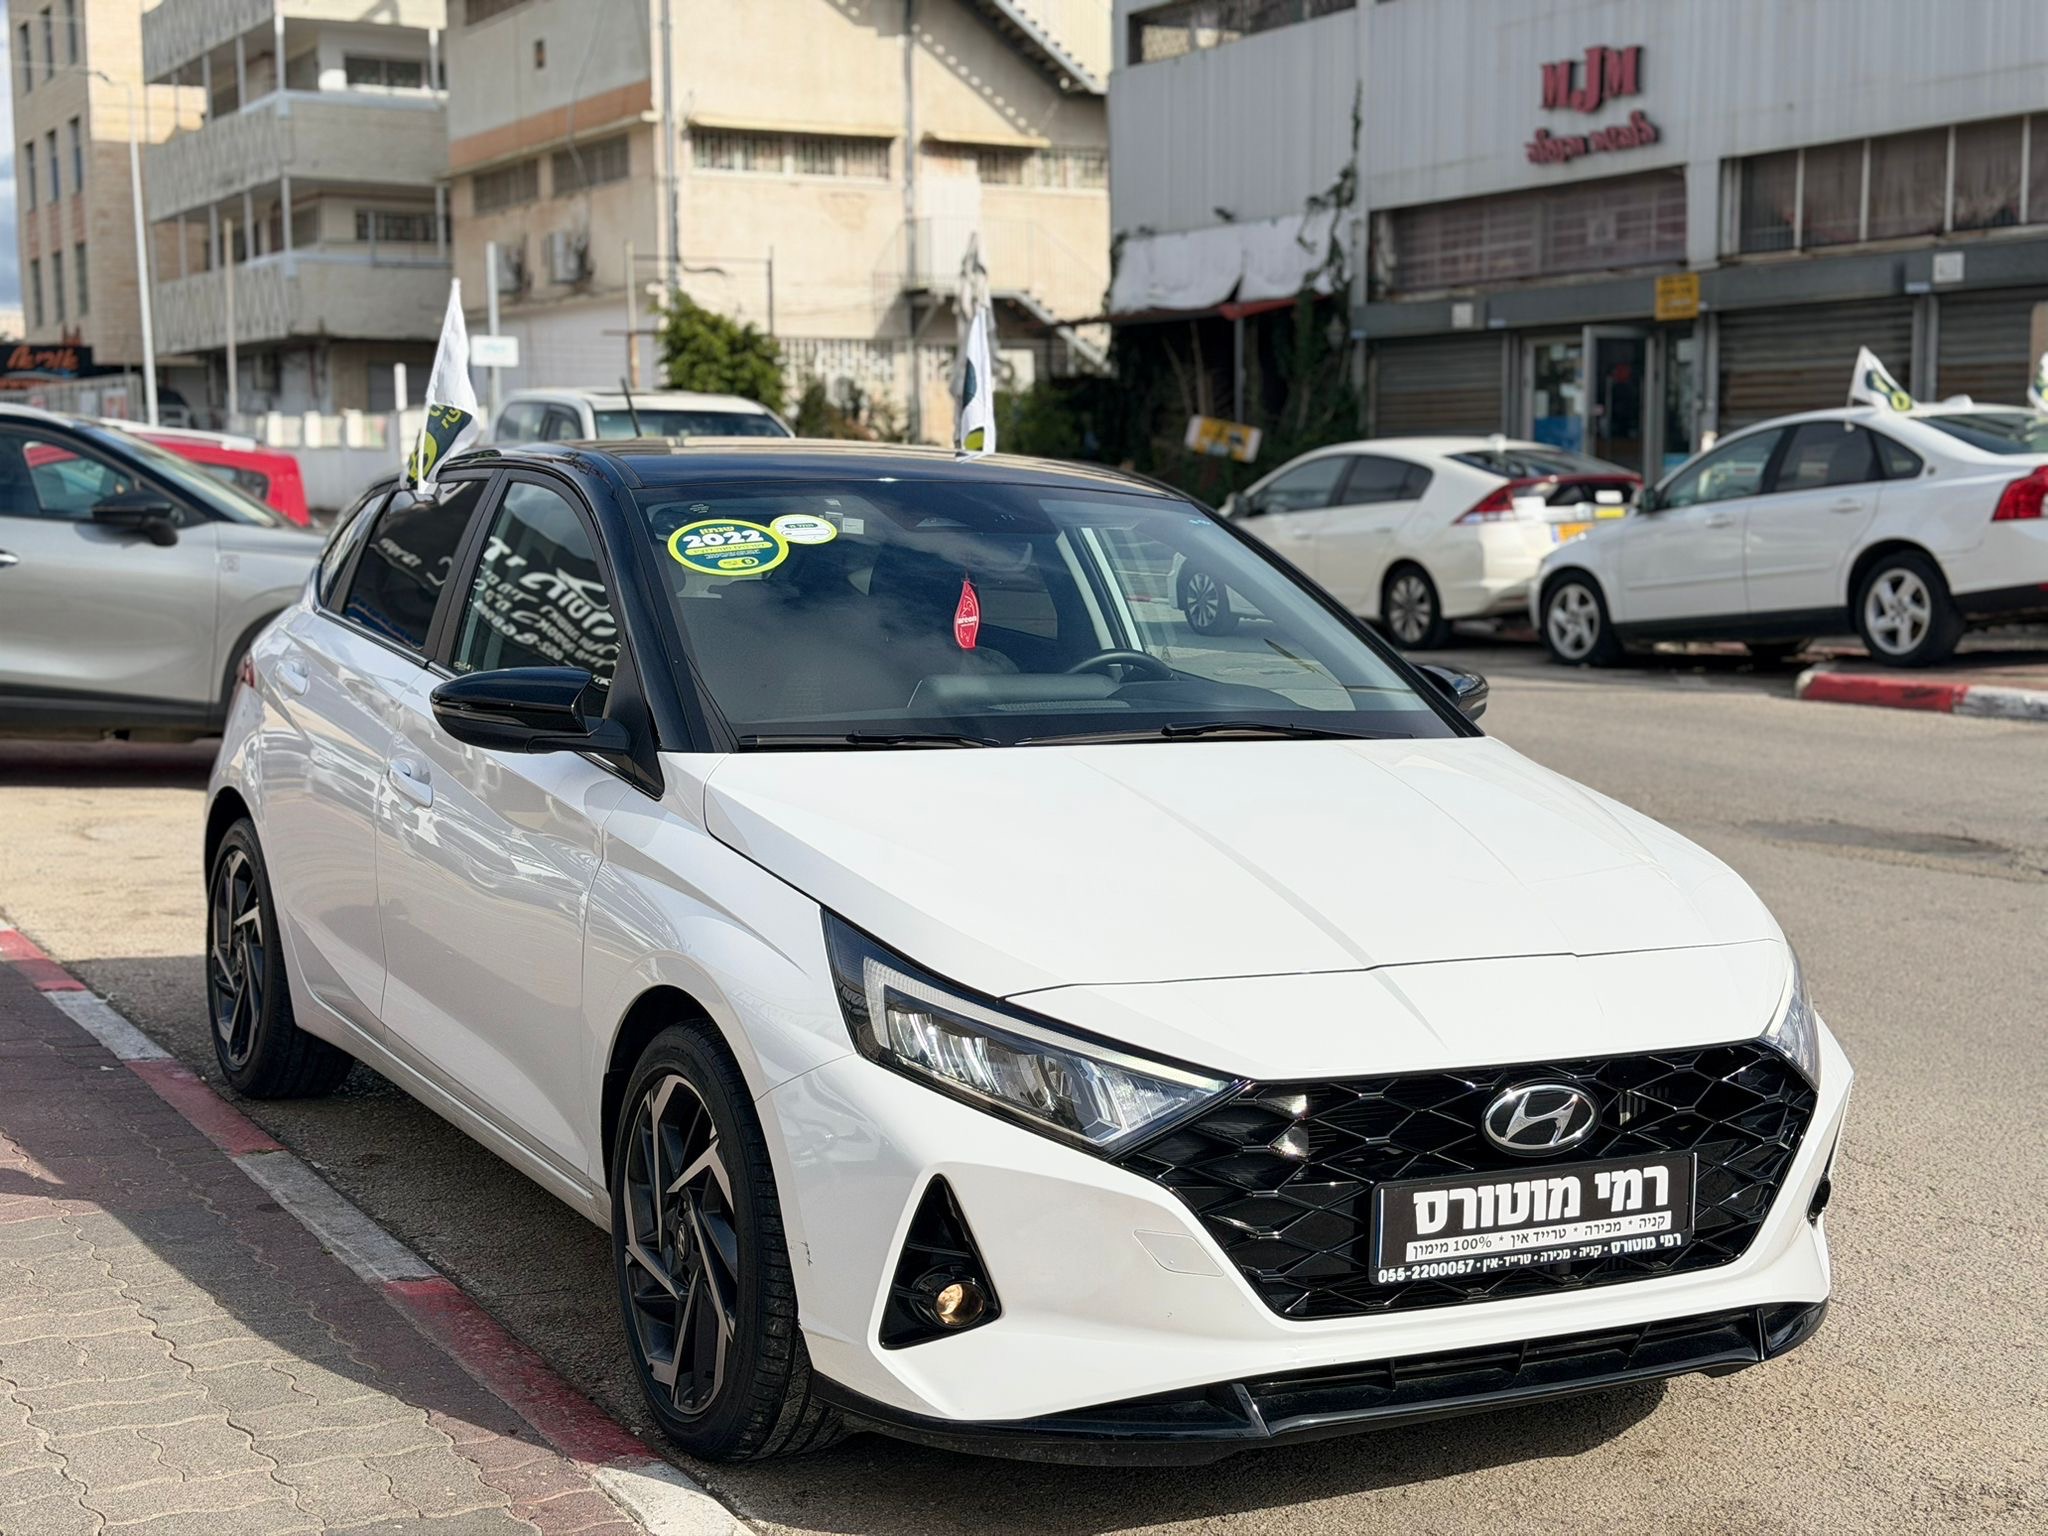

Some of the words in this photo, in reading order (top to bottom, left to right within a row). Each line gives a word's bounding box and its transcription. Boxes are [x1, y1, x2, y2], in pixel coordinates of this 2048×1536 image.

[1541, 46, 1642, 114] MJM
[683, 530, 765, 549] 2022
[1594, 1165, 1669, 1212] רמי
[1413, 1175, 1581, 1235] מוטורס
[1584, 1220, 1622, 1236] מכירה
[1639, 1215, 1666, 1229] קניה
[1453, 1235, 1492, 1251] 100%
[1610, 1236, 1657, 1255] מוטורס
[1659, 1233, 1682, 1247] רמי
[1412, 1241, 1449, 1260] מימון
[1540, 1248, 1571, 1263] מכירה
[1579, 1245, 1602, 1259] קניה
[1377, 1259, 1475, 1284] 055-2200057
